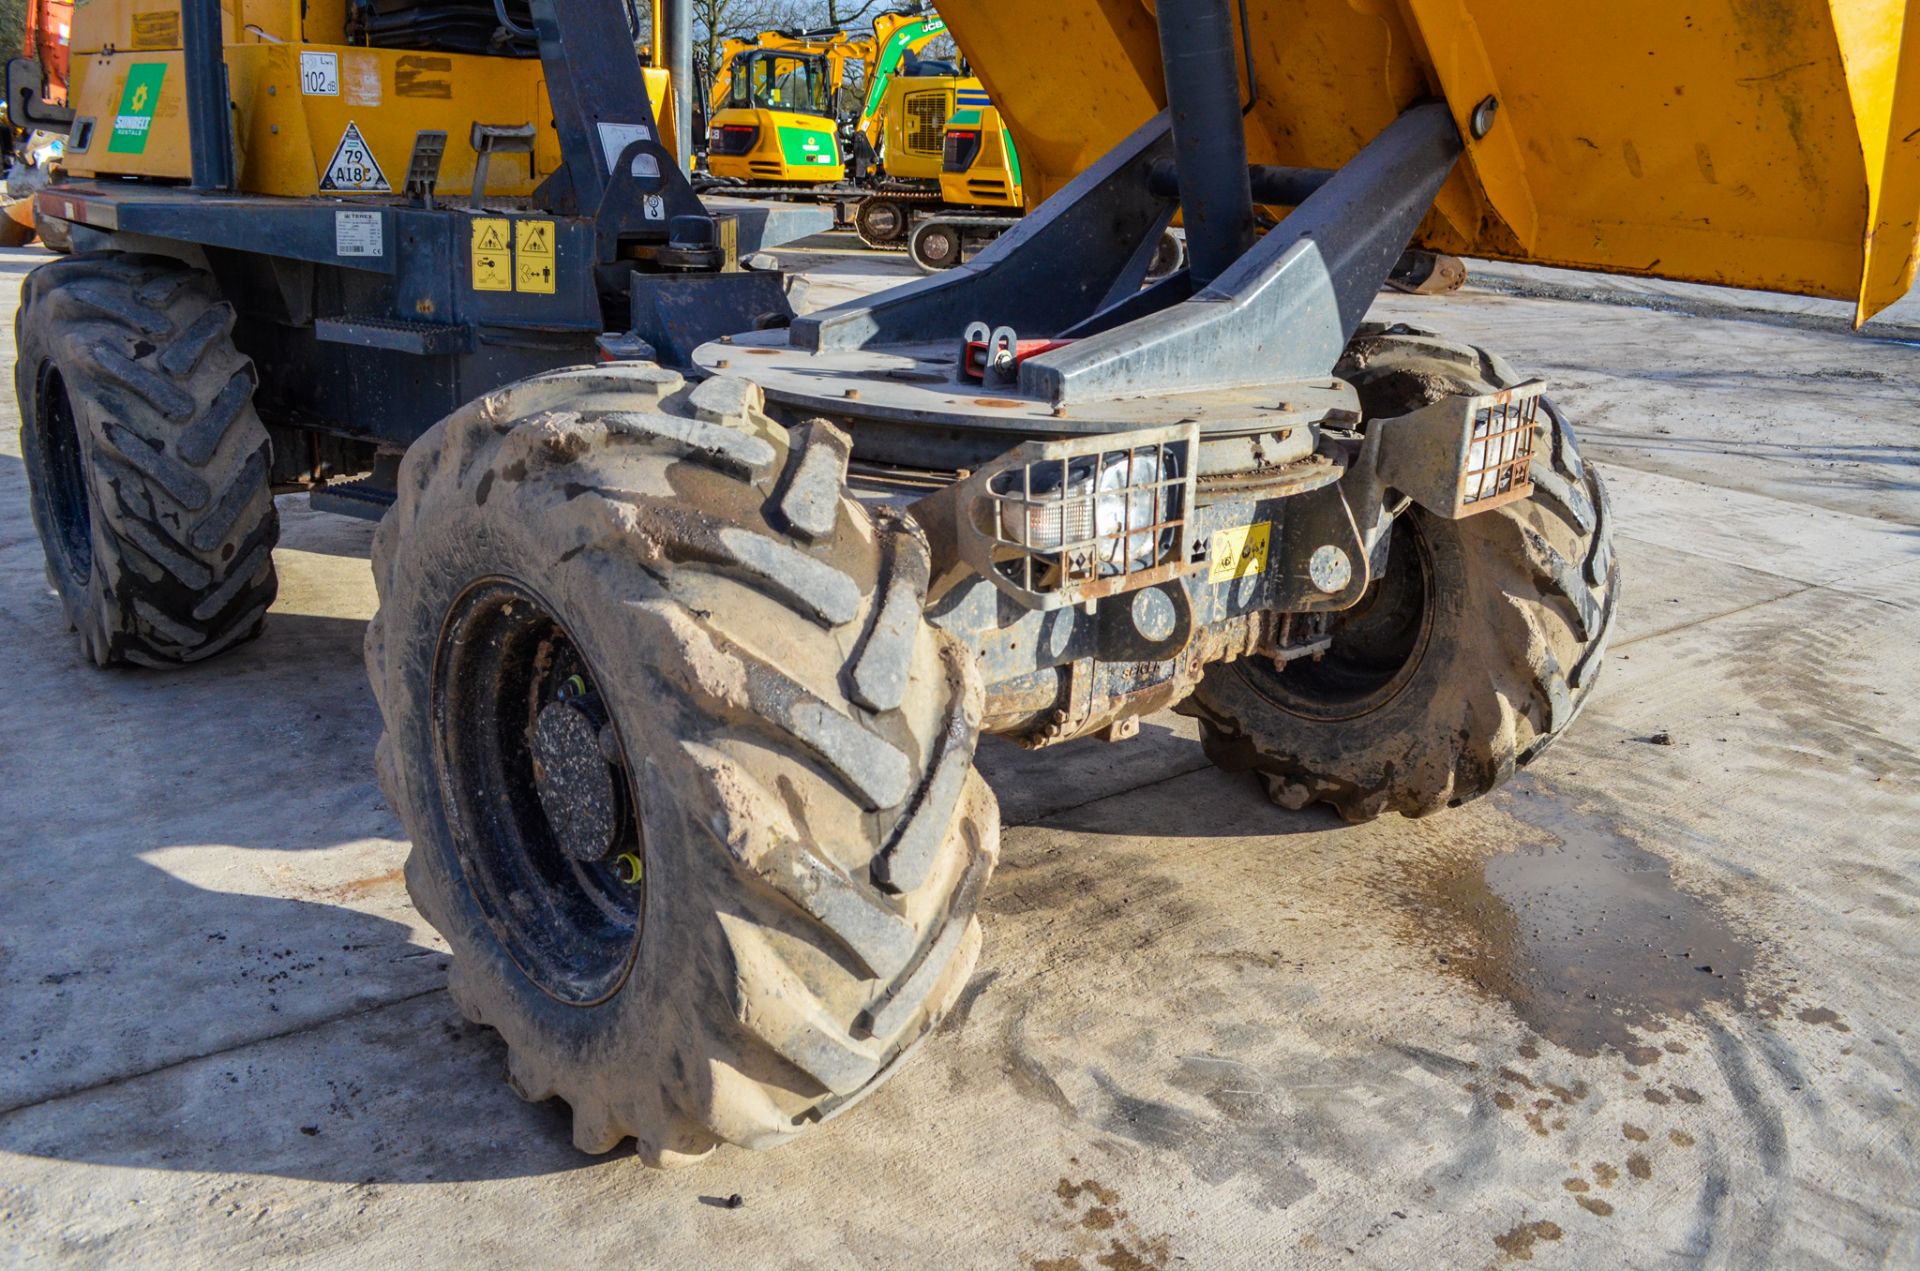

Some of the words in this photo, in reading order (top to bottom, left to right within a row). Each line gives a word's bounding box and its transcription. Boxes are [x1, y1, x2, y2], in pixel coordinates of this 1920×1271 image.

[922, 20, 944, 33] JCB
[305, 71, 326, 92] 102
[114, 115, 151, 130] SUNBELT
[344, 150, 363, 165] 79
